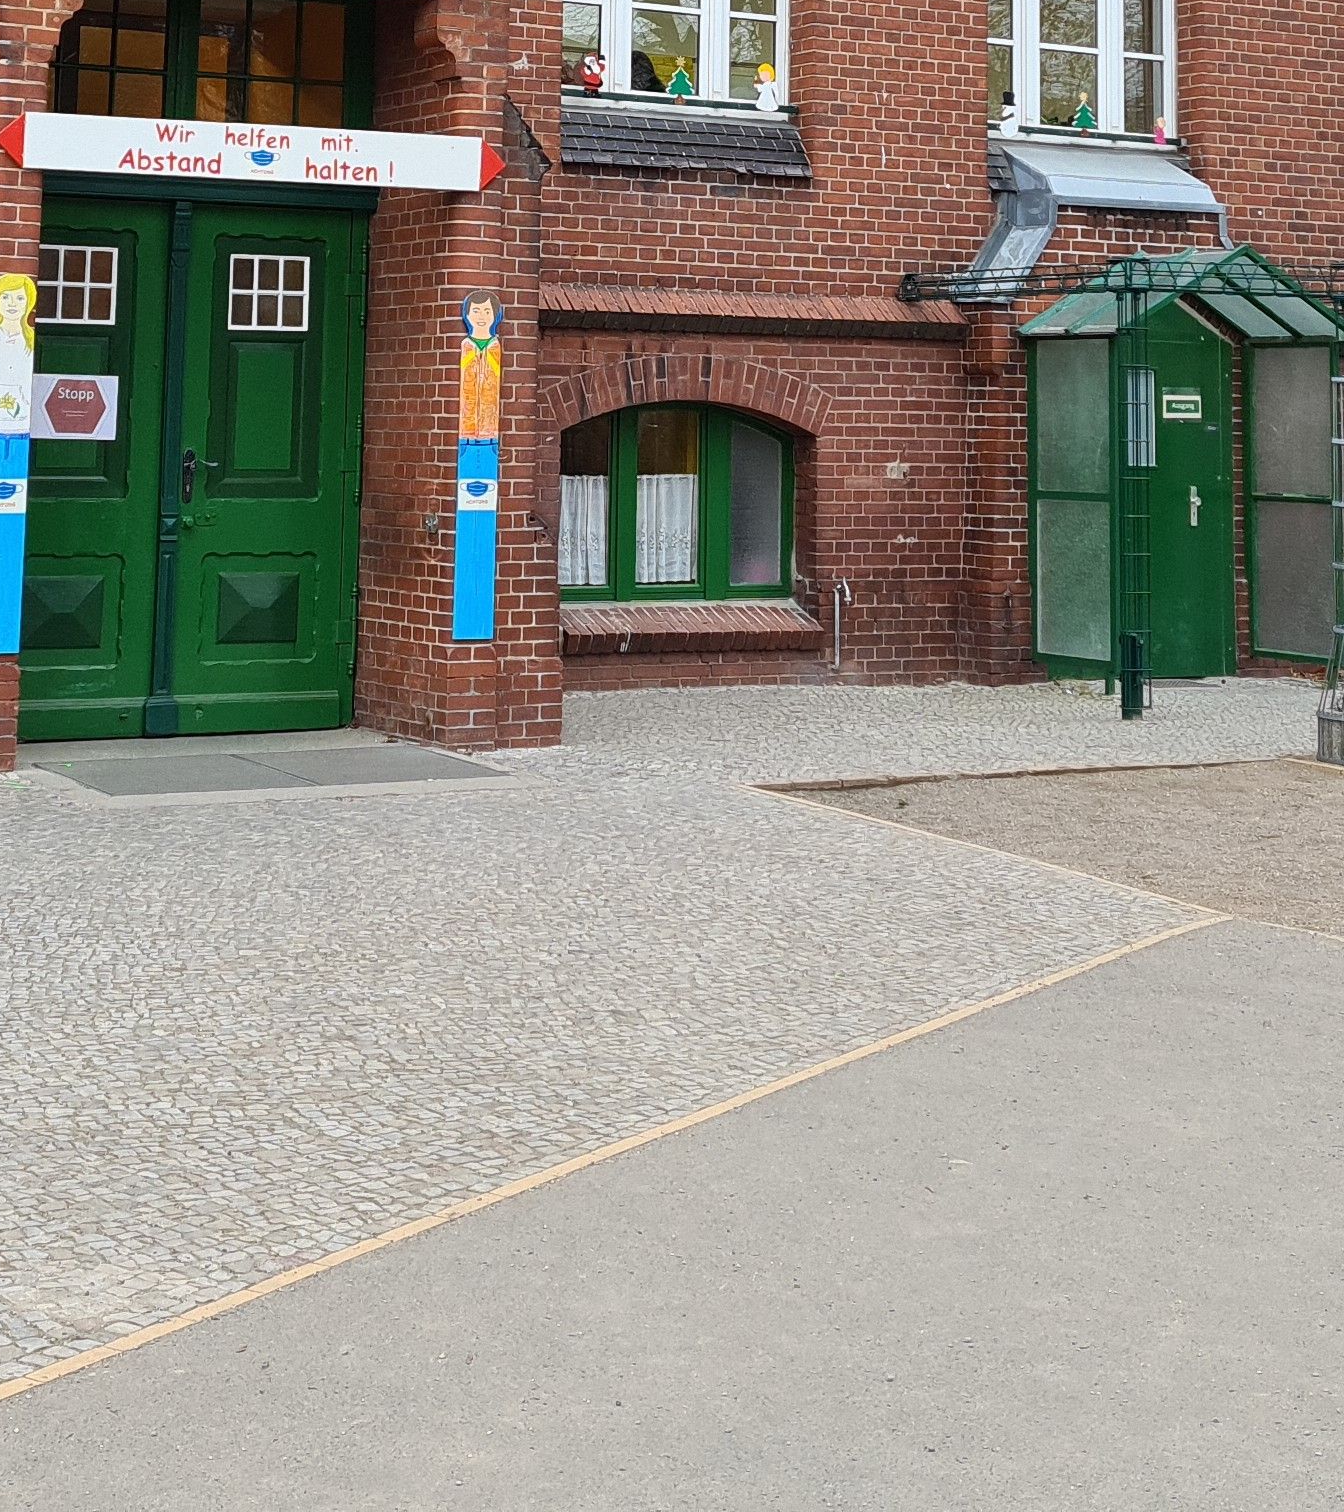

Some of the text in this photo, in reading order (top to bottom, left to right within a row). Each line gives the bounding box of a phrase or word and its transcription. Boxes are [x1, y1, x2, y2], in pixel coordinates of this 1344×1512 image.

[155, 123, 359, 153] Wir helfen mit.
[118, 147, 222, 175] Abstand
[305, 156, 378, 183] halten
[57, 387, 95, 403] Stopp
